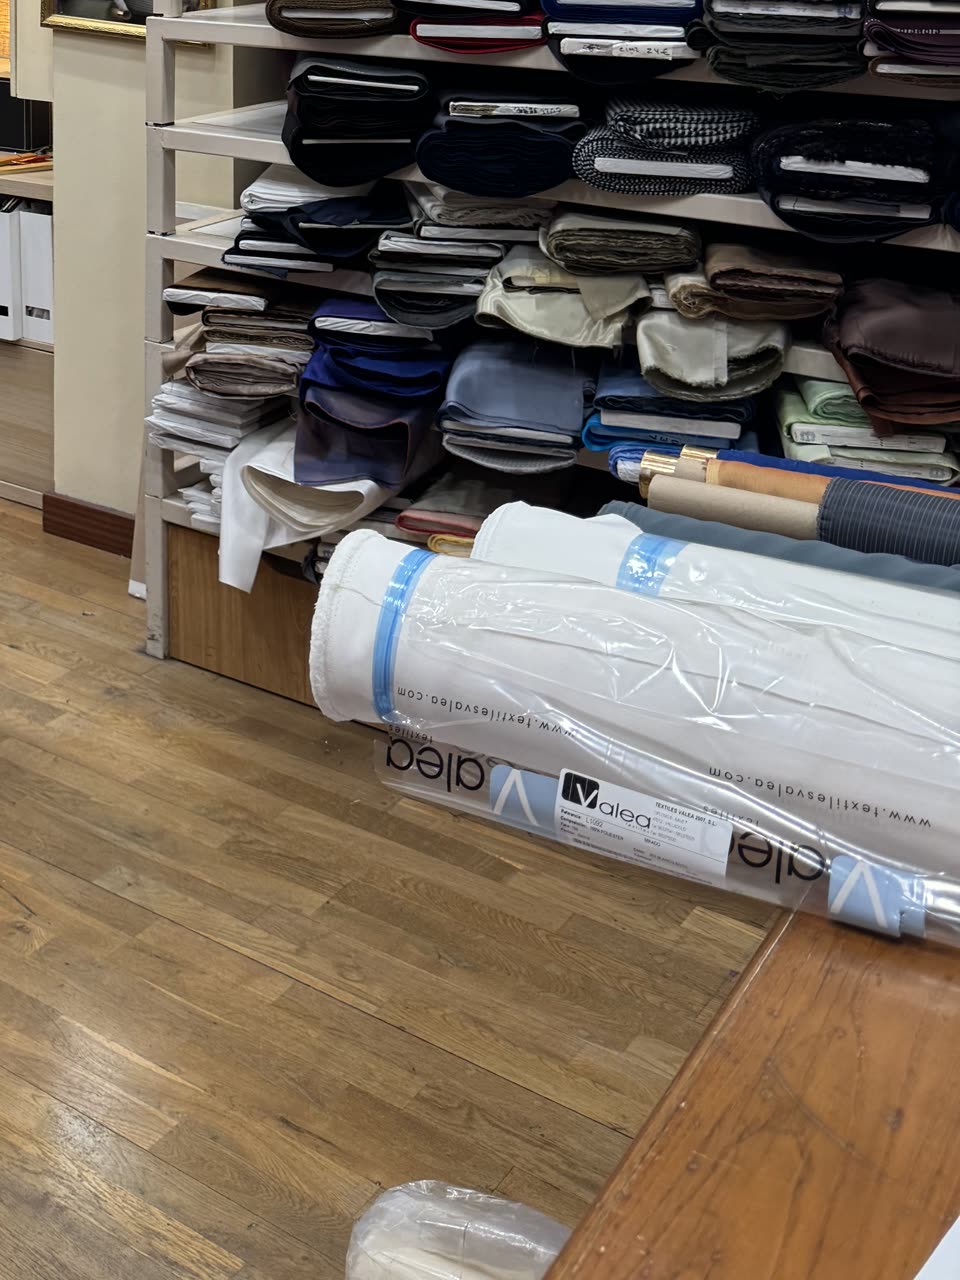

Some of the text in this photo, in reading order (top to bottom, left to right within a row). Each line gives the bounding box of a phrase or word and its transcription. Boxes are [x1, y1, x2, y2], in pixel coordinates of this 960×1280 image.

[388, 724, 433, 745] textiles
[709, 766, 932, 828] www.textilesvalea.com
[655, 801, 678, 814] TEXTILES
[678, 810, 695, 820] VALEA
